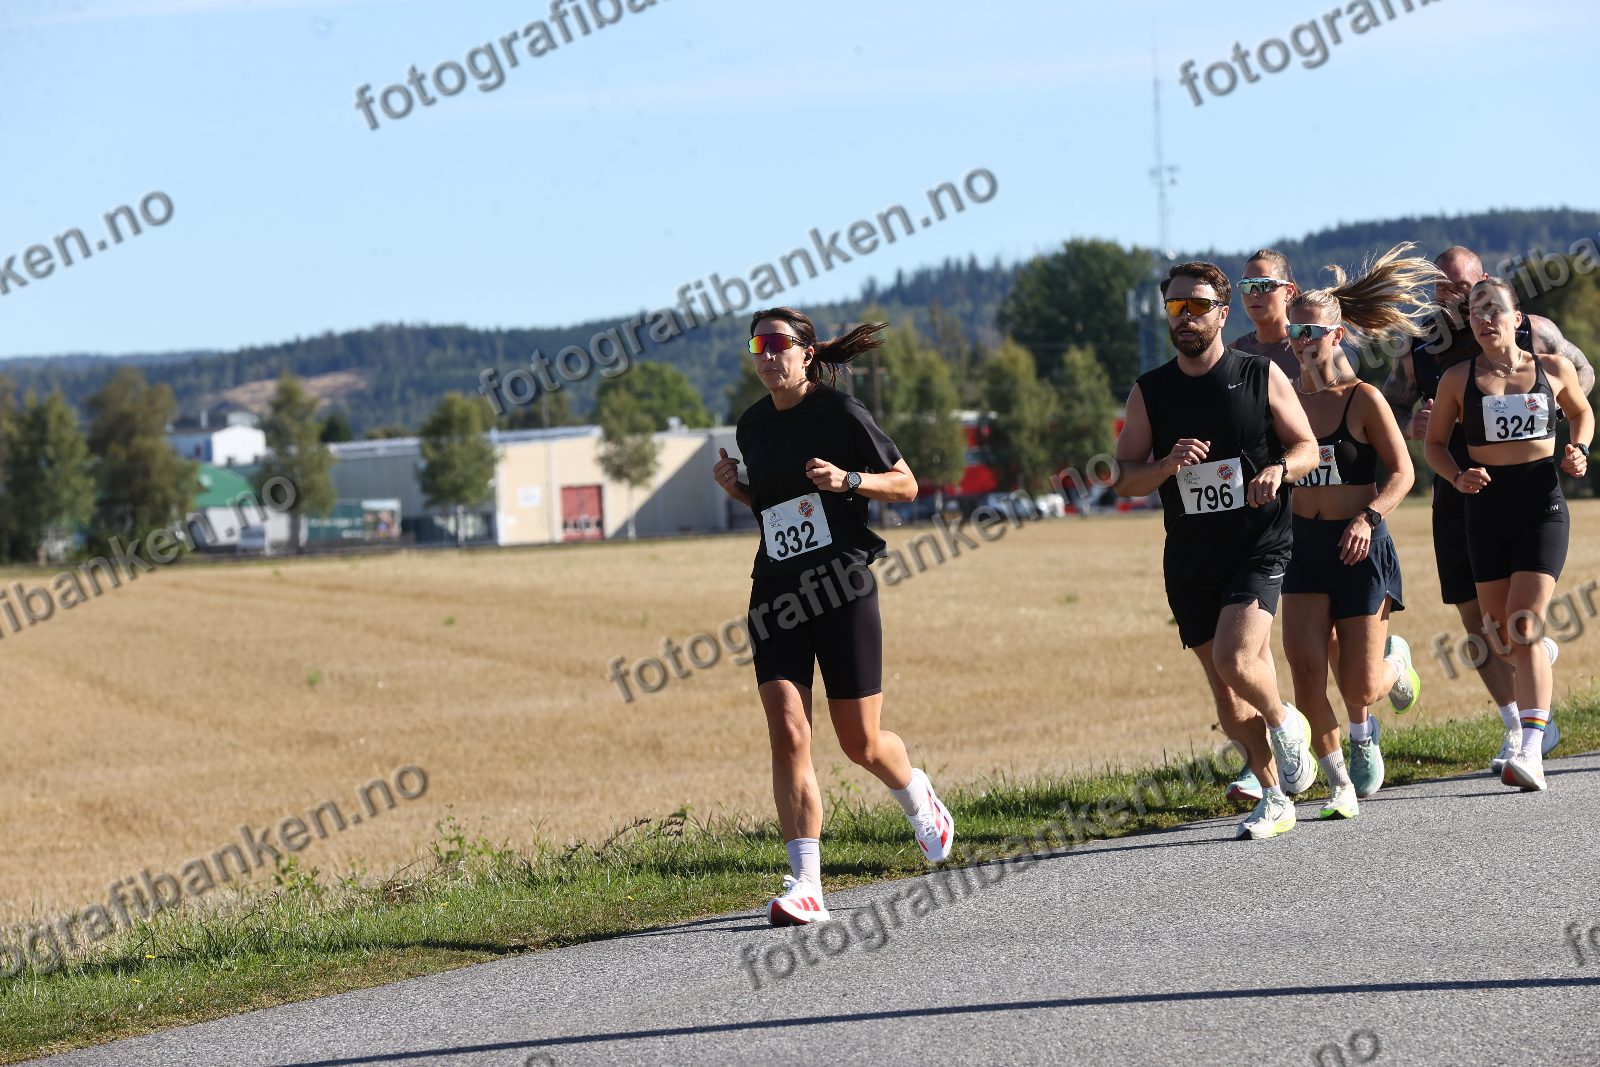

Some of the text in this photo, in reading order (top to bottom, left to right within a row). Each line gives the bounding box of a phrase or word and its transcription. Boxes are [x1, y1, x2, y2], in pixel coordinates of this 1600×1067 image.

[1496, 415, 1535, 439] 324
[1190, 483, 1233, 511] 796
[775, 521, 819, 557] 332
